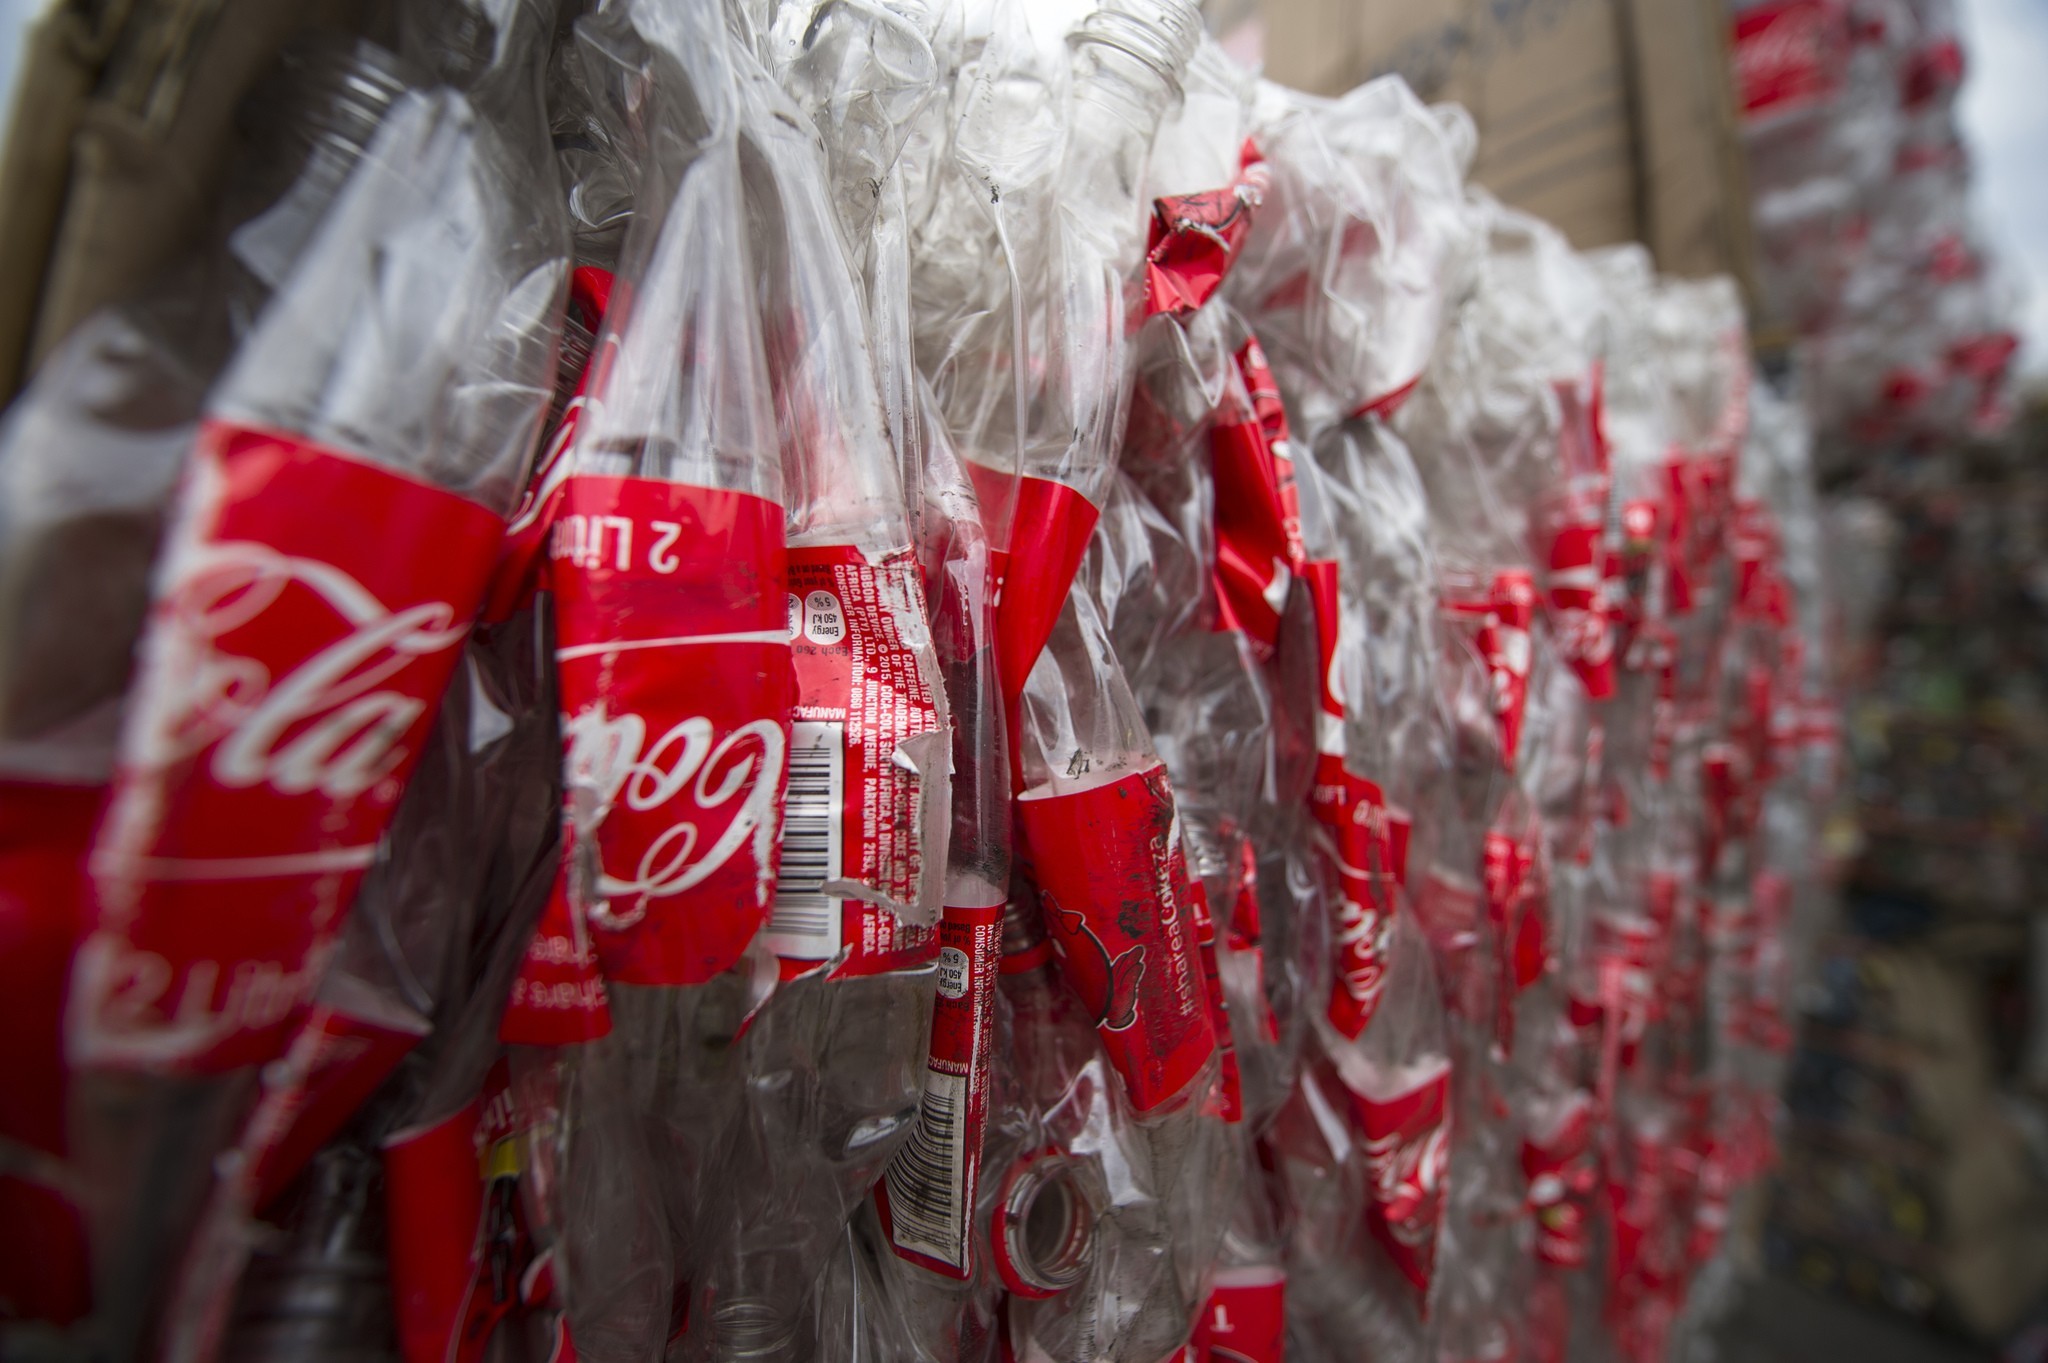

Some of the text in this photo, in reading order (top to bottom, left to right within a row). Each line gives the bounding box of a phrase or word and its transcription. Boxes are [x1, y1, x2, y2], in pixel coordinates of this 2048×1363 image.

[648, 520, 682, 574] 2
[846, 565, 863, 601] AFRICA
[812, 614, 837, 624] 450 kJ
[812, 625, 839, 637] Energy
[853, 607, 870, 631] (PTY)
[866, 606, 883, 641] DEVICE.
[880, 616, 898, 650] OWNER
[820, 646, 848, 656] Each
[834, 565, 863, 747] CONSUMER INFORMATION: 0860 112526.
[864, 637, 875, 662] LTD.,
[892, 654, 902, 667] OF
[880, 656, 890, 682] 2015.
[893, 671, 905, 688] THE
[902, 654, 920, 703] CAFFEINE.
[866, 678, 877, 723] JUNCTION
[880, 686, 893, 738] COCA-COLA
[862, 729, 876, 773] AVENUE,
[862, 778, 877, 837] PARKTOWN
[877, 778, 891, 821] AFRICA,
[879, 821, 891, 830] A
[894, 829, 907, 857] COKE
[862, 914, 875, 956] AFRICA.
[974, 925, 986, 973] CONSUMER
[949, 969, 962, 979] 450
